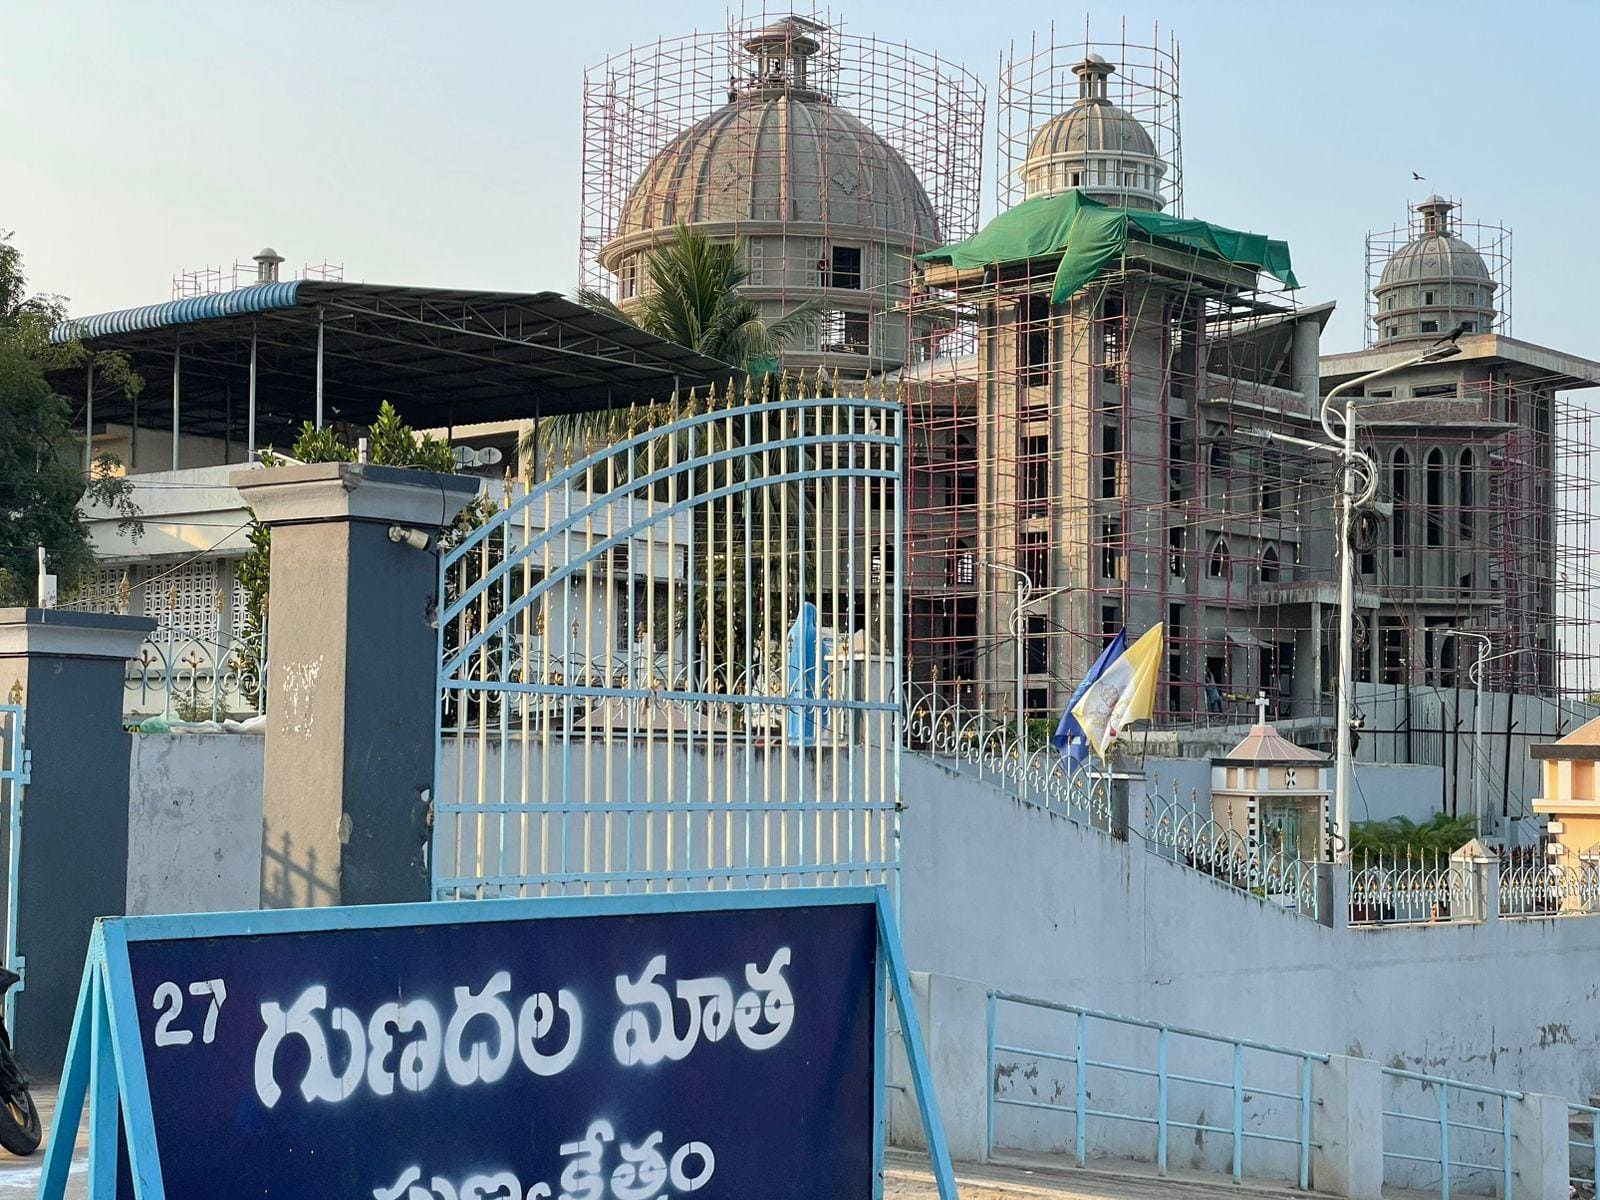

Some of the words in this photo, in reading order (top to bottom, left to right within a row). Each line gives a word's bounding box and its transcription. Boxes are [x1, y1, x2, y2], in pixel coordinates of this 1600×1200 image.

[152, 978, 227, 1047] 27
[253, 970, 583, 1109] గుణదల
[611, 946, 795, 1067] మాత
